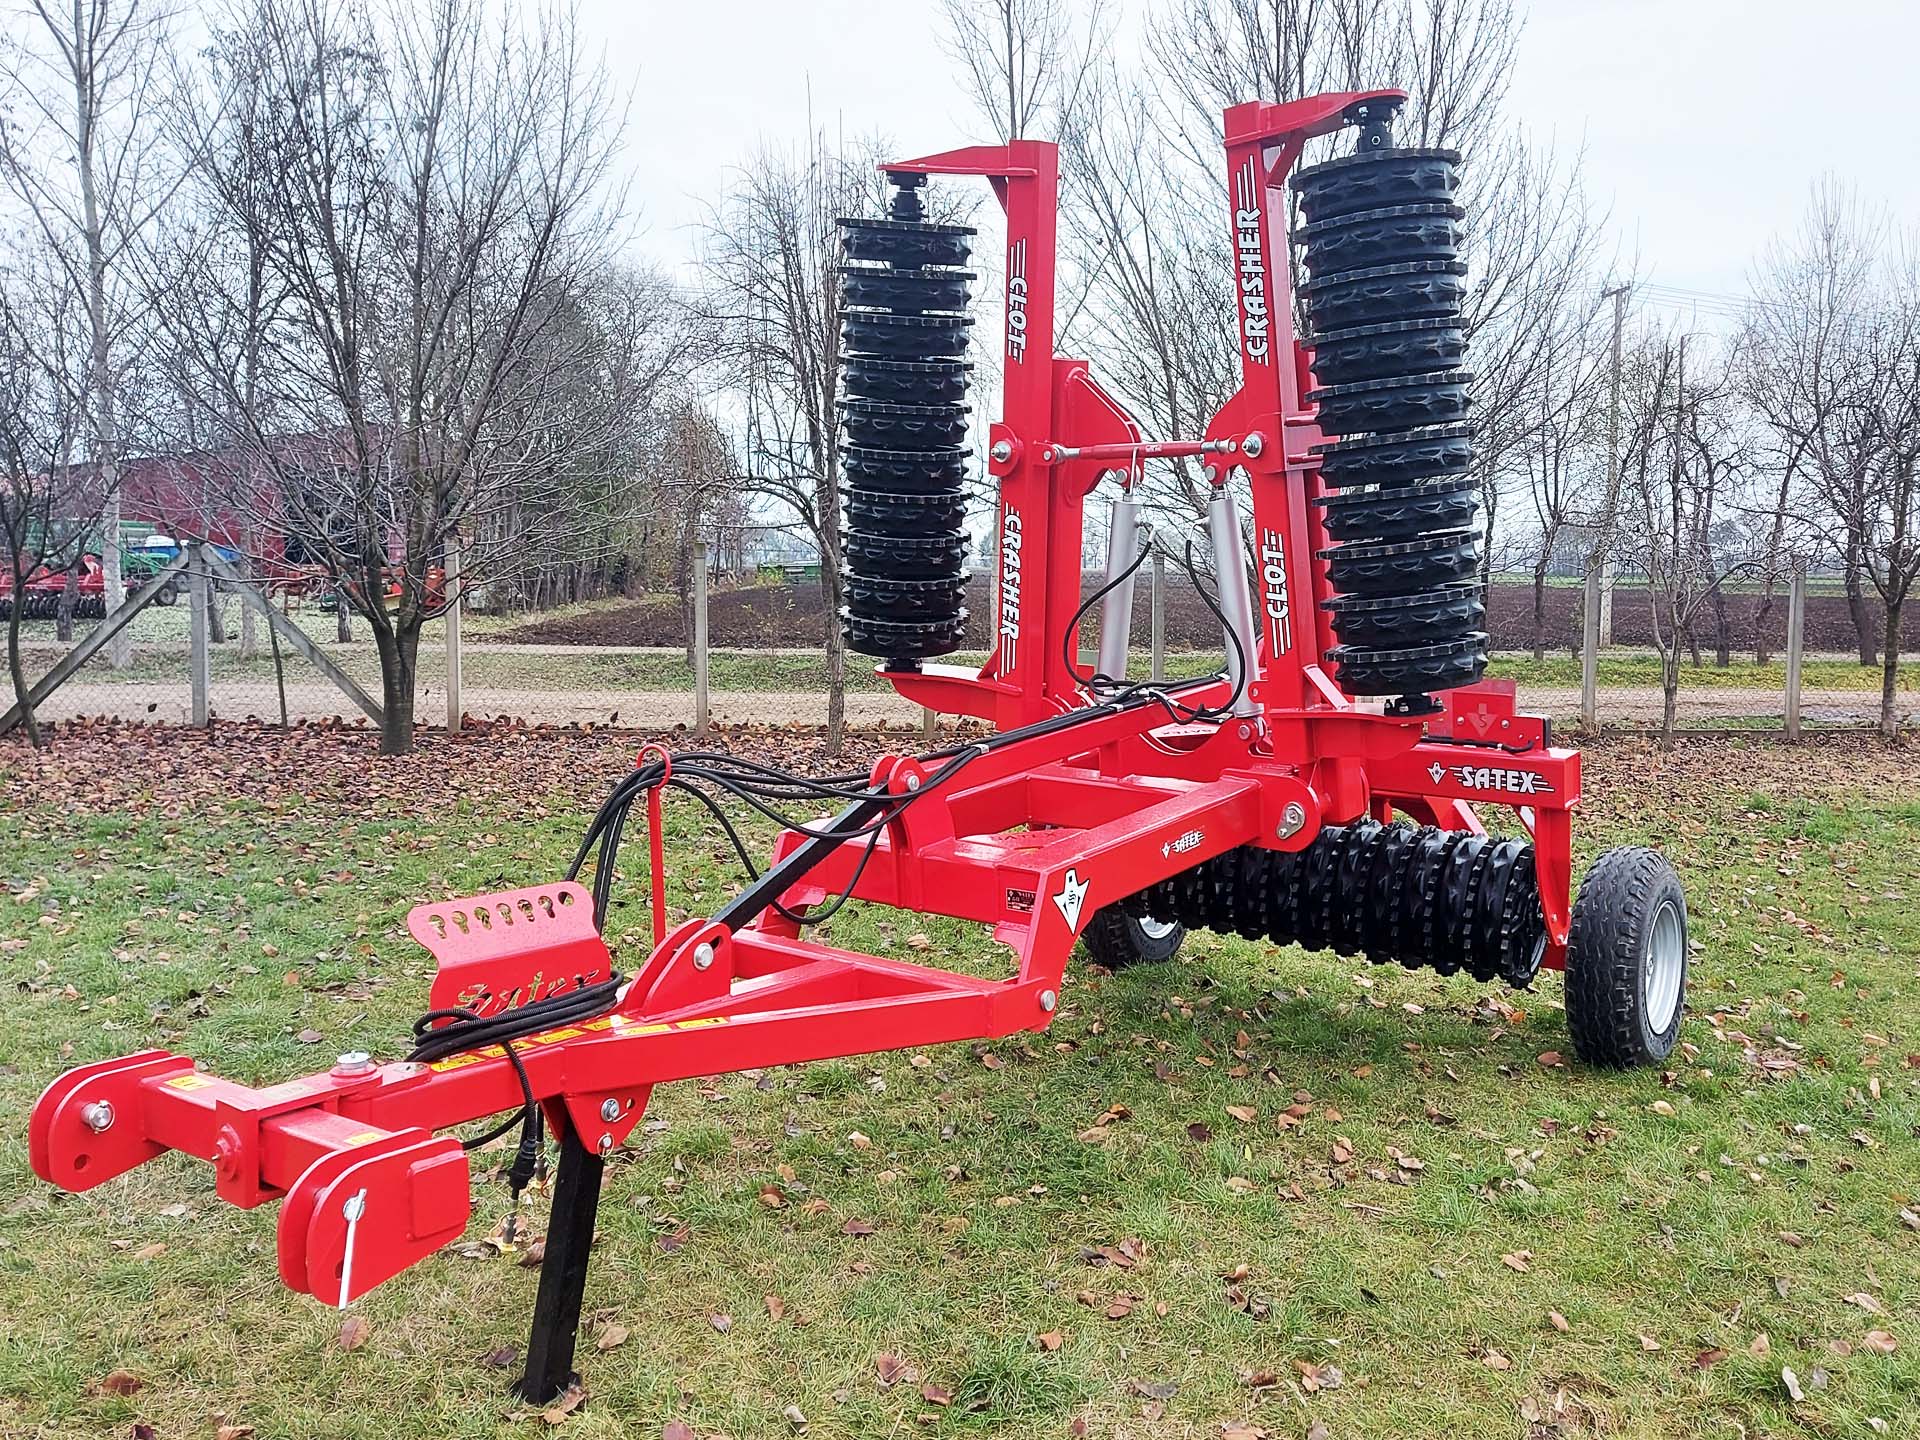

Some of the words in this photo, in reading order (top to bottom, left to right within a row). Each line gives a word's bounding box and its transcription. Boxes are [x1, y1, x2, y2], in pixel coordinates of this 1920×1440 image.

[1008, 276, 1028, 351] CLOT
[1236, 207, 1270, 357] CRASHER
[1000, 513, 1022, 641] CRASHER
[1261, 543, 1290, 620] CLOT
[1461, 765, 1537, 795] SATEX
[1174, 830, 1202, 853] SATEX
